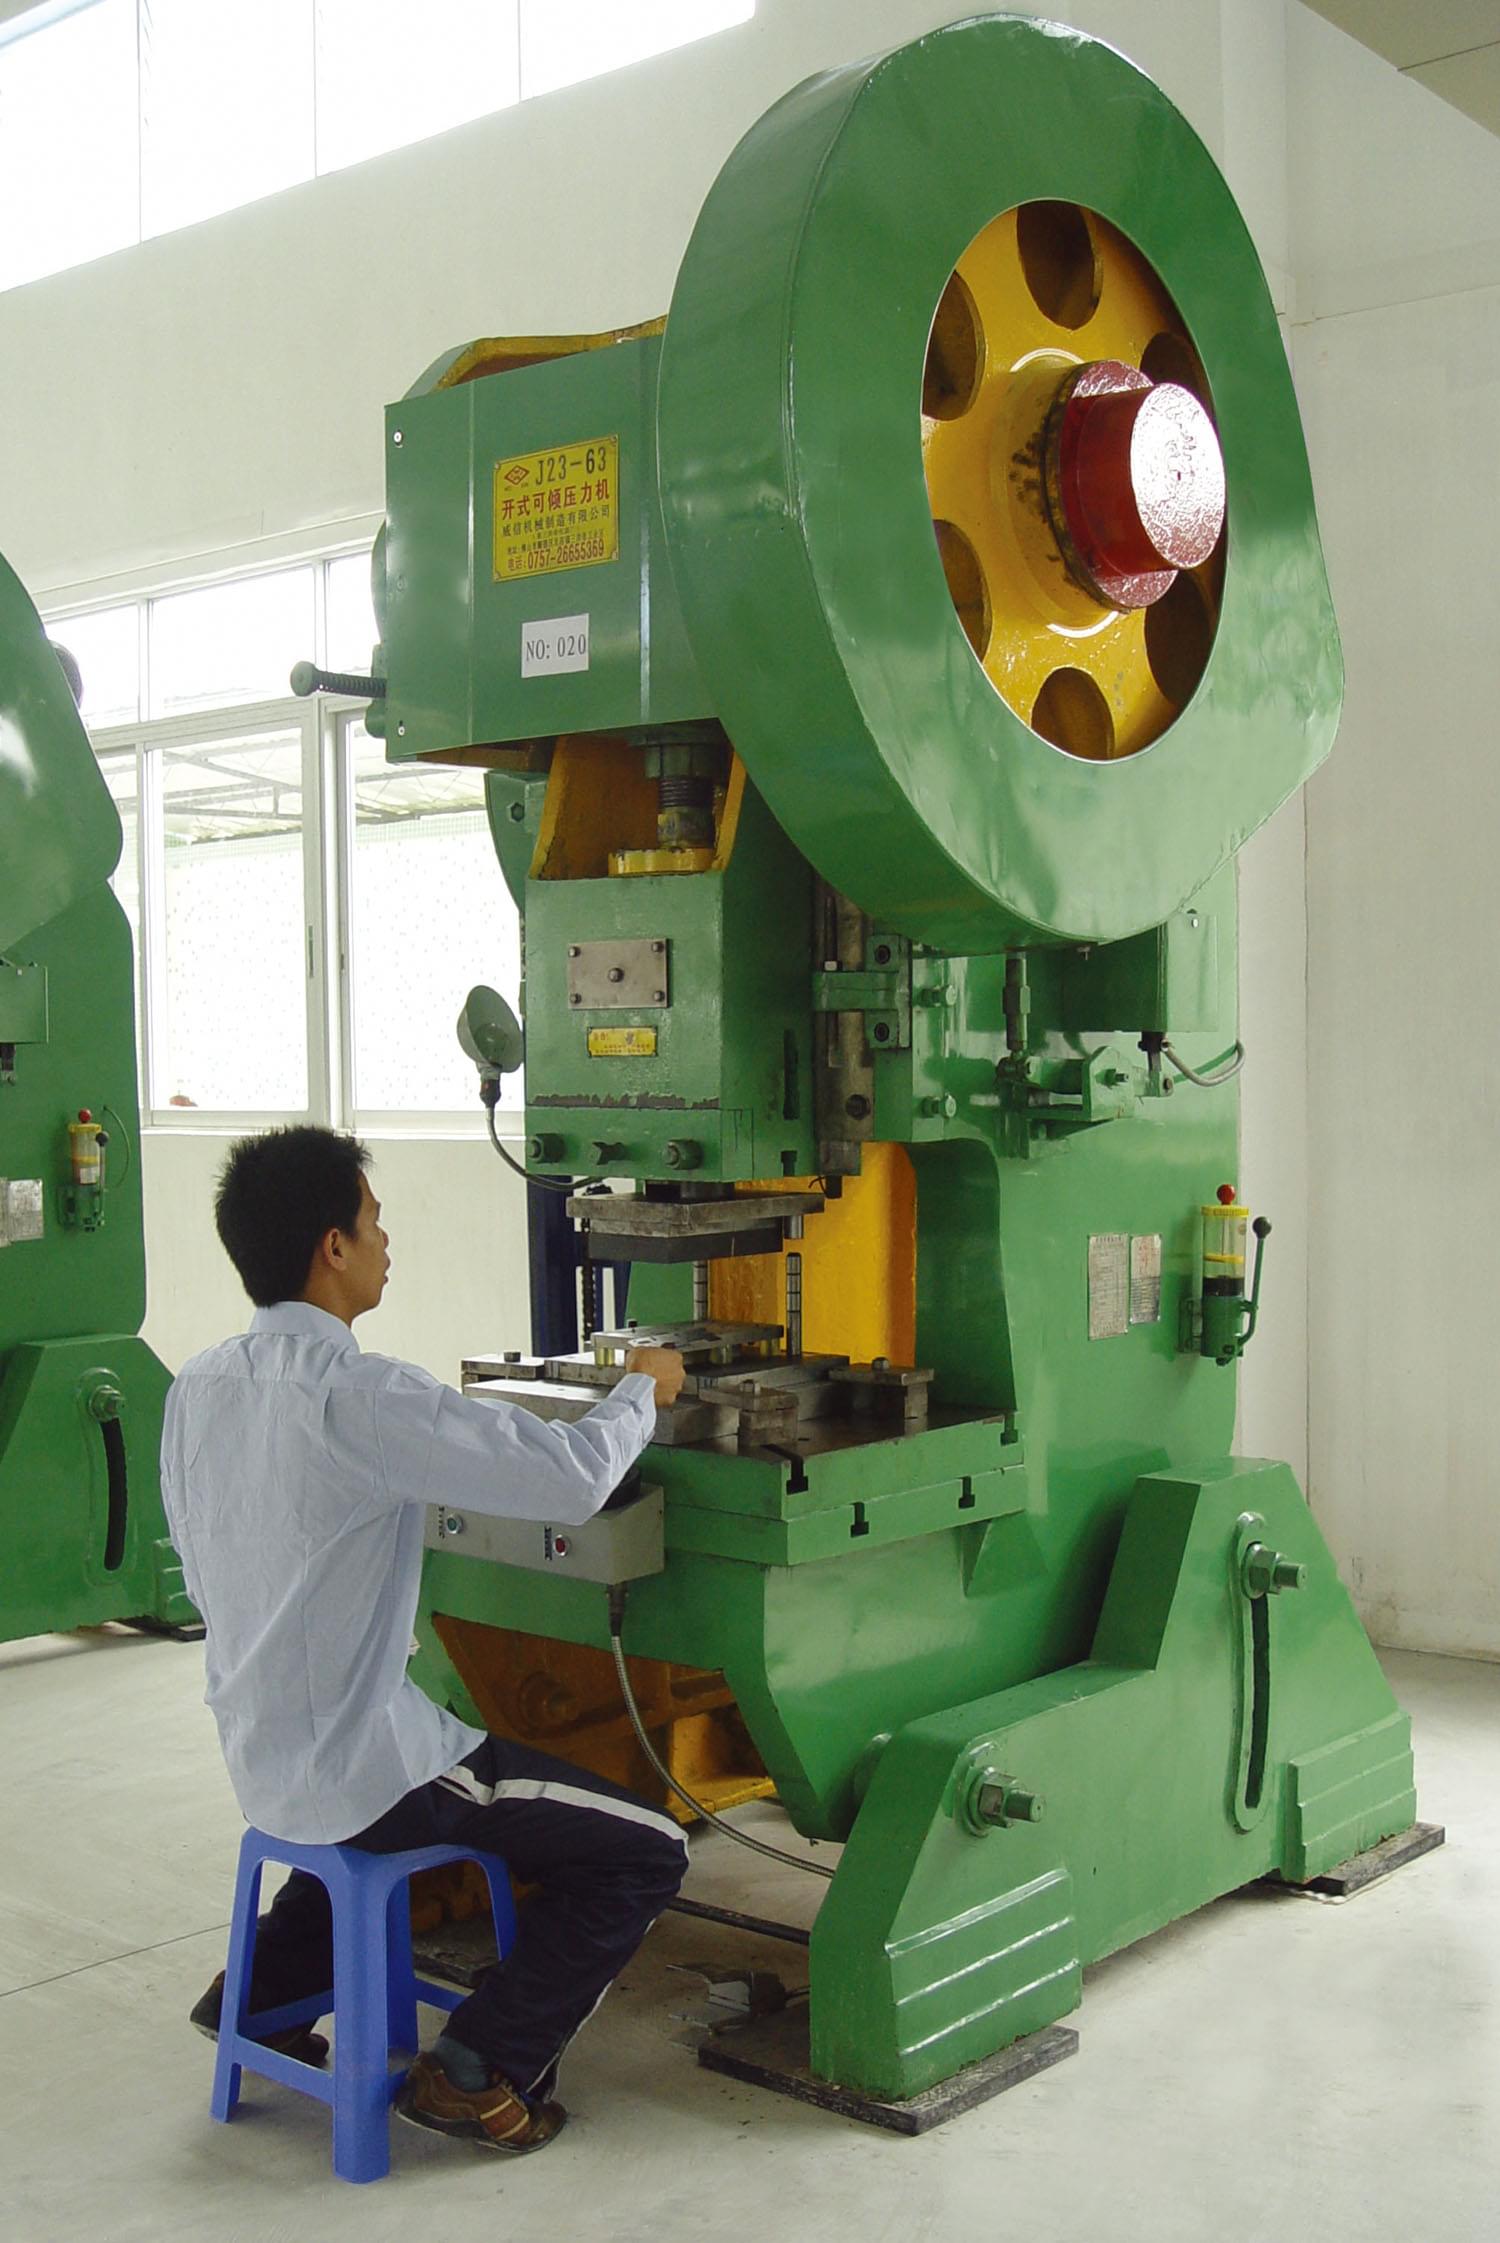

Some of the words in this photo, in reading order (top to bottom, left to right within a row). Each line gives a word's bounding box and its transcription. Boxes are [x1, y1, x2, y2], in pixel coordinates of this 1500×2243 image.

[502, 479, 609, 520] 开式可倾压力机
[526, 639, 550, 661] NO:
[557, 634, 586, 657] 020
